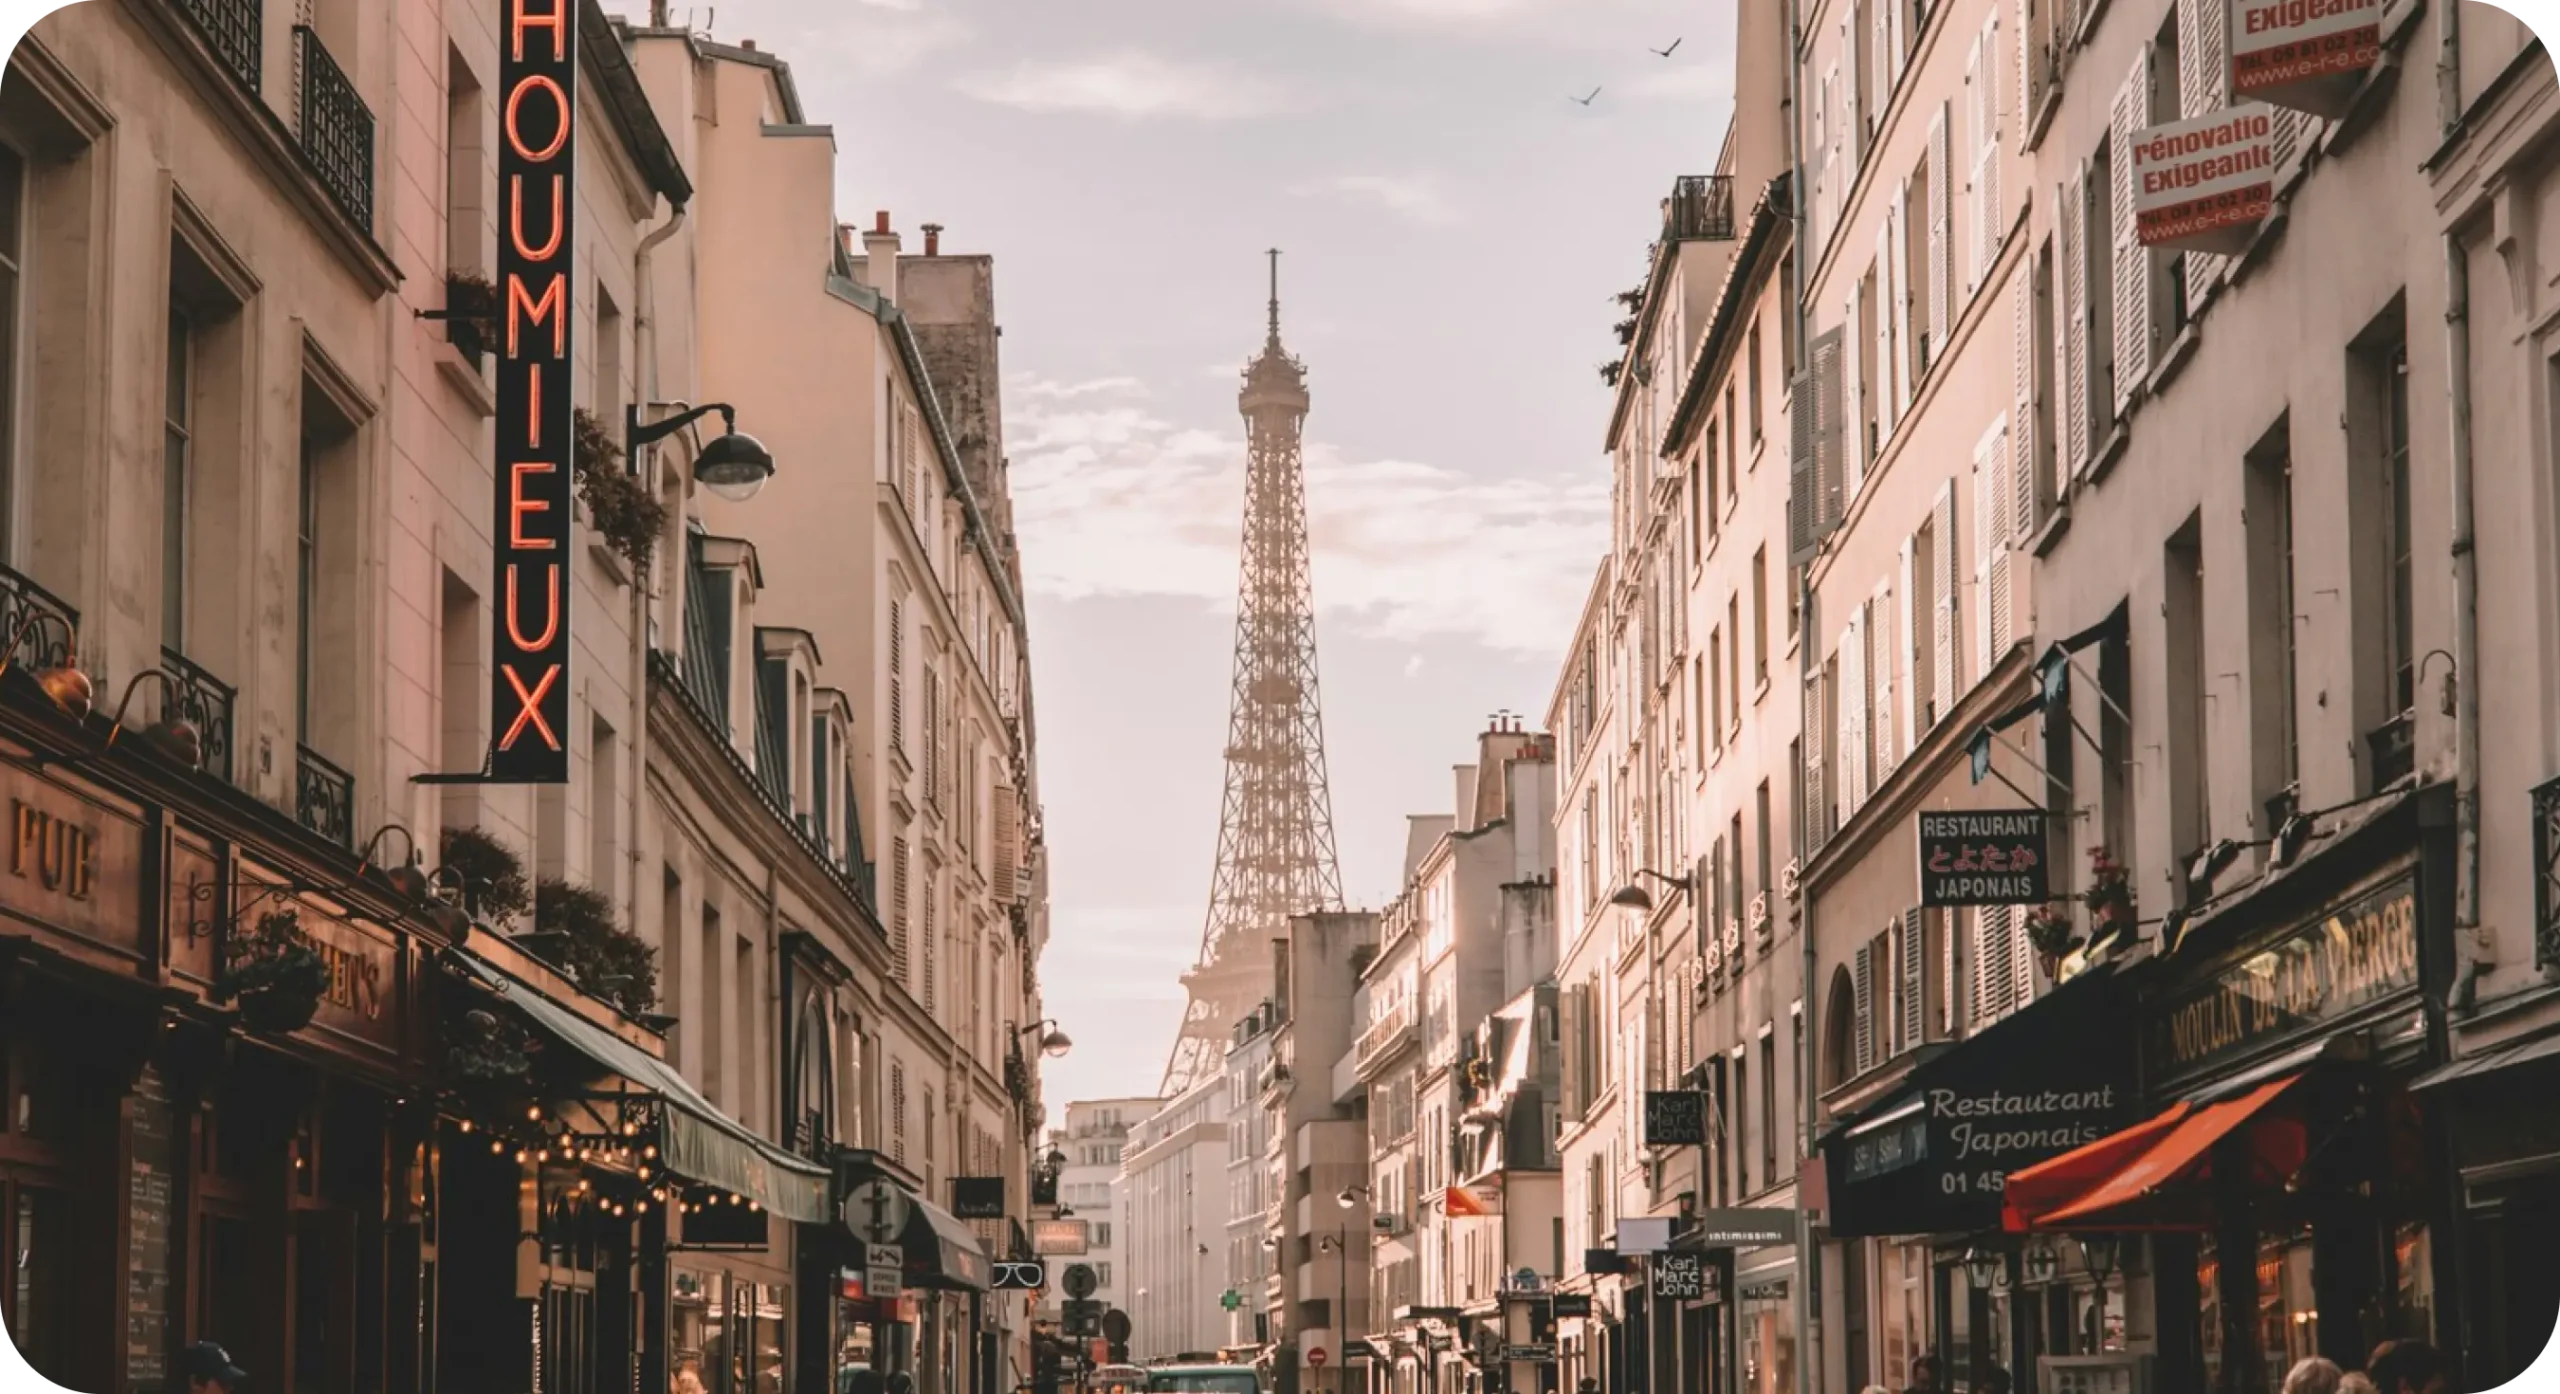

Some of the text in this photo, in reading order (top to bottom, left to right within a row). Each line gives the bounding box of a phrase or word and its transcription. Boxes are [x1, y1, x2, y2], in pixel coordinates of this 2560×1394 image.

[499, 0, 570, 752] HOUMIEUX
[1923, 815, 2040, 838] RESTAURANT
[1928, 843, 2038, 873] とよたか
[1935, 876, 2032, 899] JAPONAIS
[2172, 984, 2244, 1063] MOULIN
[2250, 967, 2279, 1033] DE
[2286, 946, 2321, 1017] LA
[1658, 1096, 1698, 1112] Karl
[1929, 1084, 2115, 1118] Restaurant
[1648, 1110, 1698, 1126] Marc
[1650, 1125, 1698, 1140] John
[1950, 1121, 2099, 1160] Japonais
[1941, 1171, 2004, 1194] 01 45
[1708, 1230, 1782, 1241] intimissimi
[1663, 1254, 1698, 1270] Karl
[1655, 1268, 1698, 1283] Marc
[1657, 1281, 1698, 1296] John
